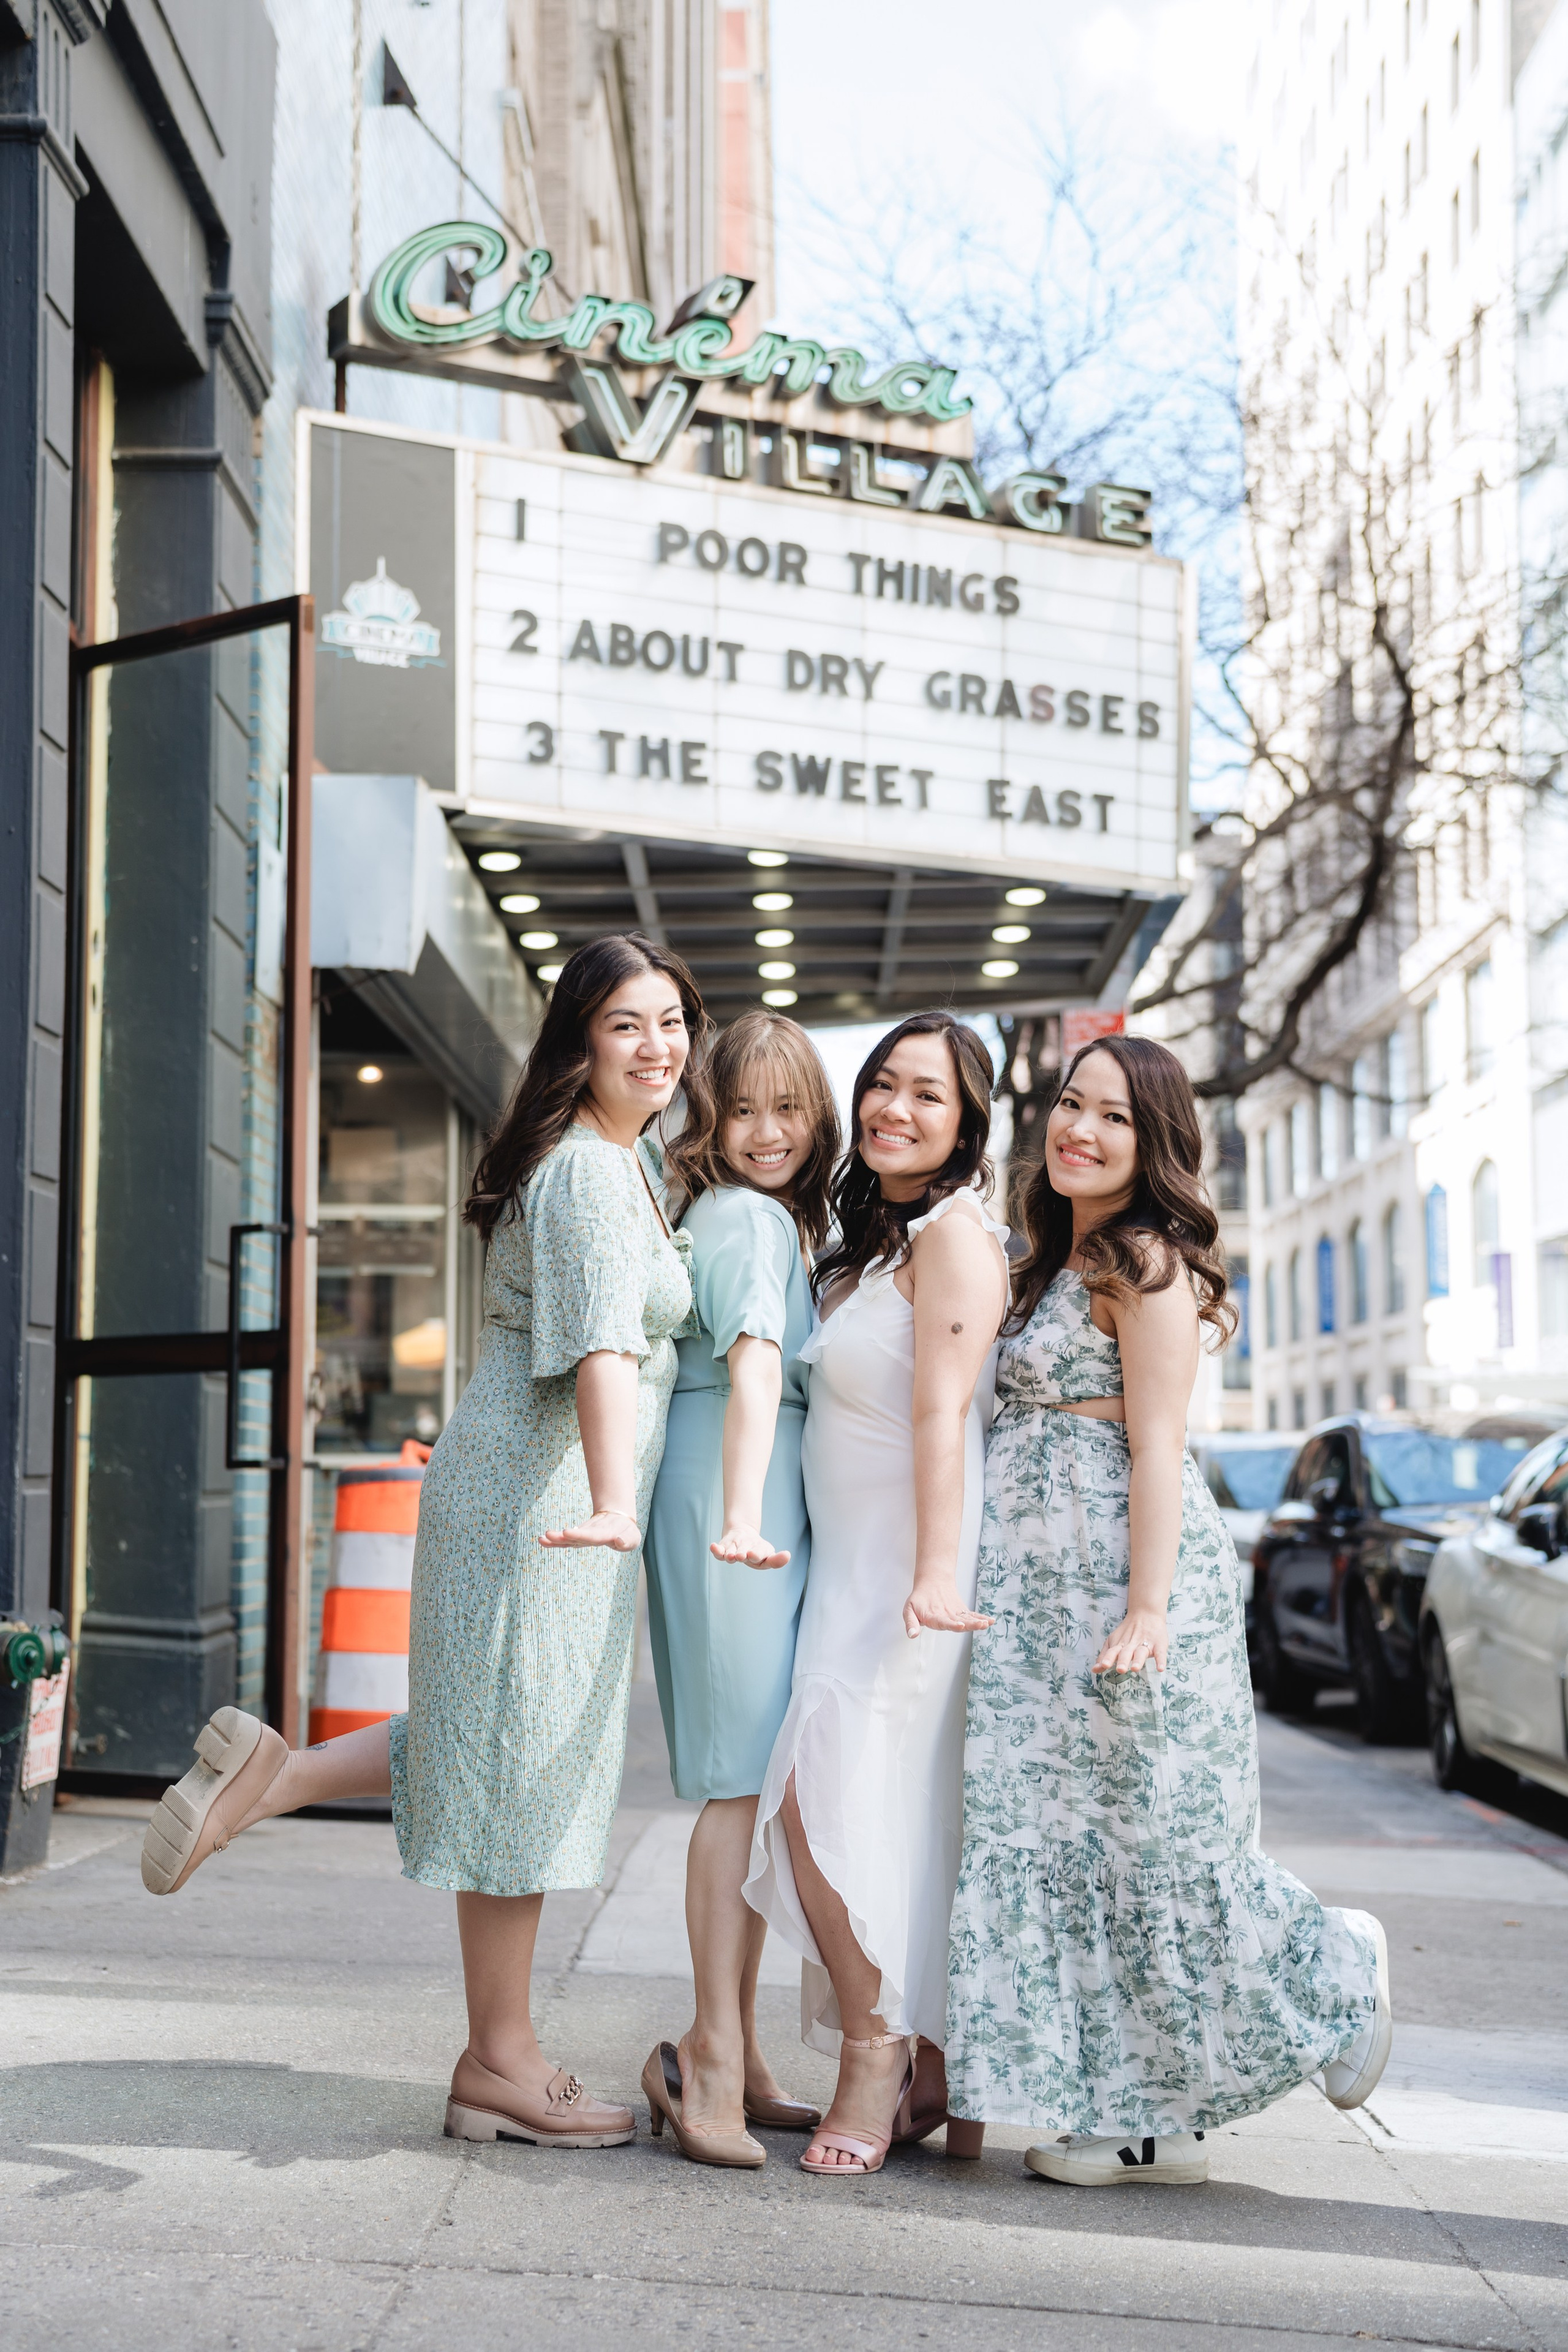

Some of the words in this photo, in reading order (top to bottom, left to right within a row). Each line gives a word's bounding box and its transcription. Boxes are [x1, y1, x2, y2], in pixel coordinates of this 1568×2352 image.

[570, 355, 1153, 549] VILLAGE
[516, 497, 527, 541] 1
[658, 521, 809, 586] POOR
[848, 551, 1021, 615] THINGS
[508, 608, 538, 654] 2
[568, 618, 745, 682] ABOUT
[785, 649, 885, 702] DRY
[925, 669, 1161, 739] GRASSES
[526, 720, 555, 765] 3
[597, 729, 709, 784] THE
[755, 750, 935, 809] SWEET
[987, 778, 1116, 833] EAST
